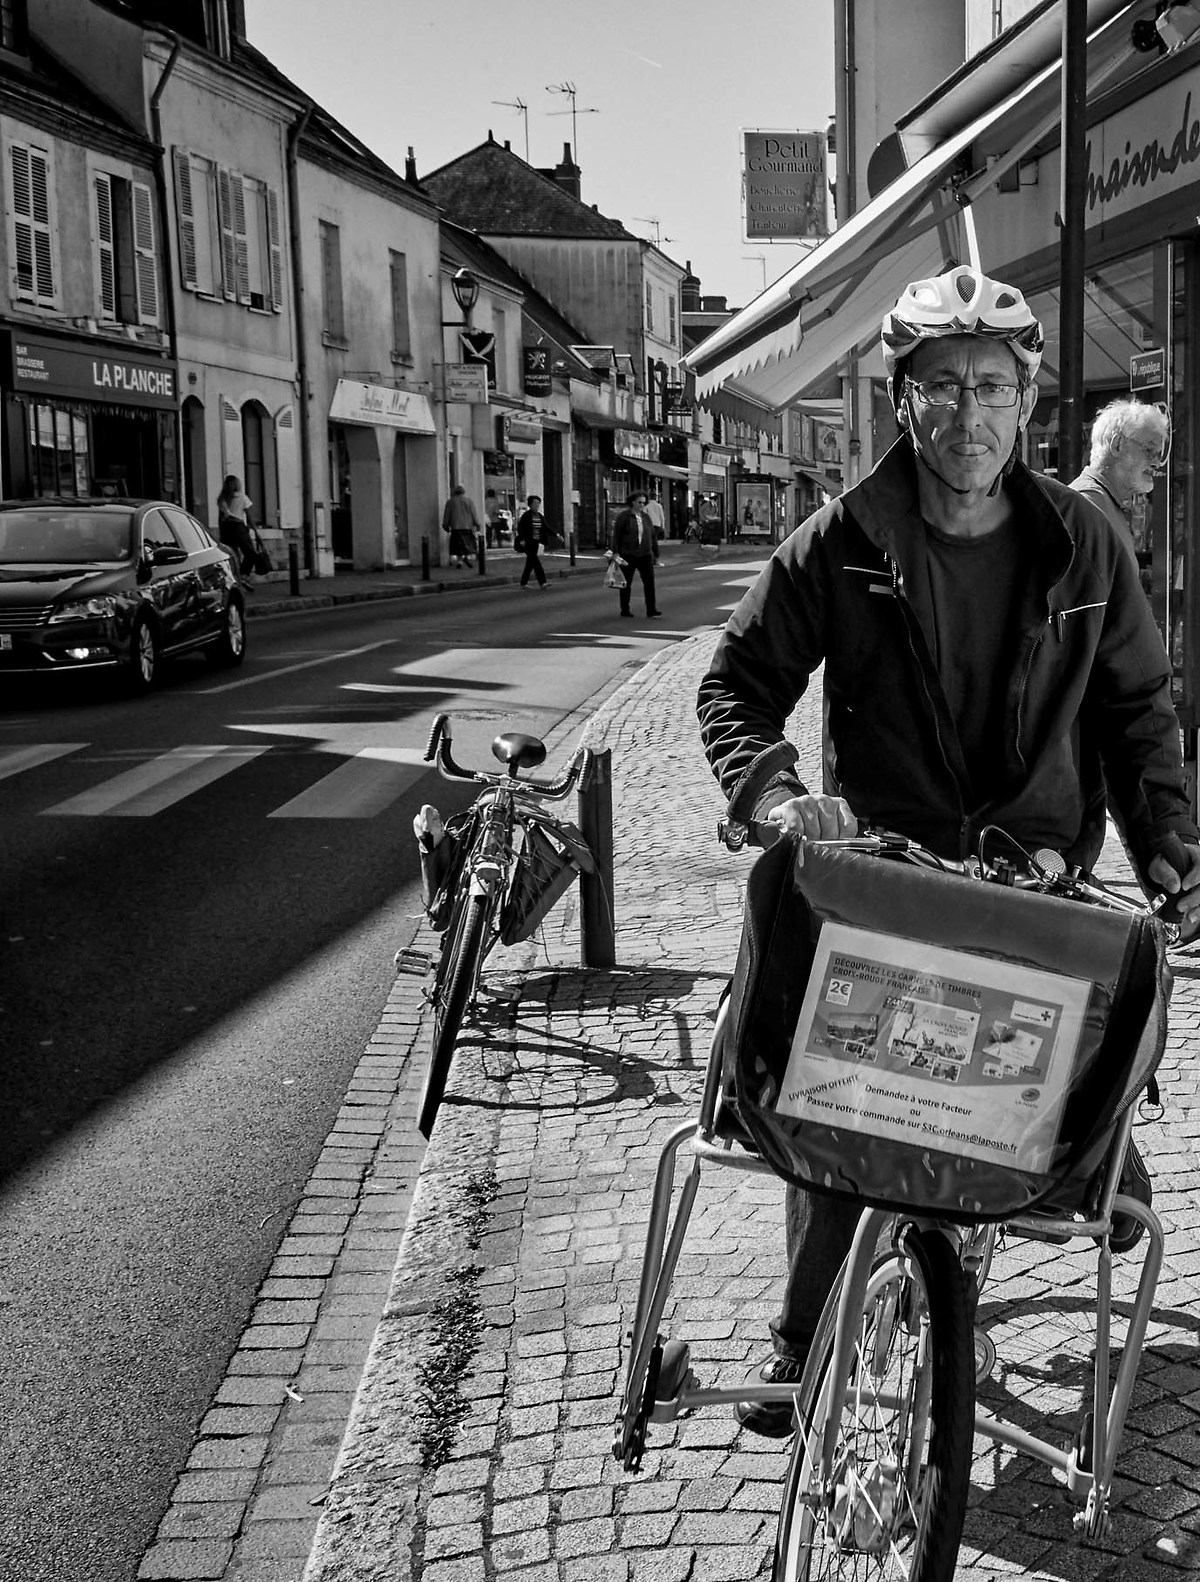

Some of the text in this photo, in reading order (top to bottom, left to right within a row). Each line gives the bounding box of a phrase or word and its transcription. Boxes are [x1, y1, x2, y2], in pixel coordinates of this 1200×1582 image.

[764, 138, 809, 159] Petit
[748, 157, 824, 174] Gourmand
[16, 345, 28, 356] BAR
[16, 357, 46, 370] BRASSERIE
[17, 368, 50, 381] RESTAURANT
[92, 362, 173, 397] LA PLANCHE
[832, 967, 931, 996] CROIX-ROUGE FRANÇAISE
[834, 957, 879, 975] DÉCOUVREZ
[882, 969, 897, 979] LES
[935, 981, 945, 990] DE
[948, 984, 982, 998] TIMBRES
[830, 981, 850, 996] 2€
[788, 1074, 858, 1101] LIVRAISON OFFERTE
[865, 1084, 973, 1116] Demandez à votre Facteur
[807, 1096, 834, 1110] Passez
[835, 1103, 858, 1115] votre
[859, 1109, 906, 1126] commande
[907, 1120, 921, 1130] sur
[909, 1108, 921, 1117] ou
